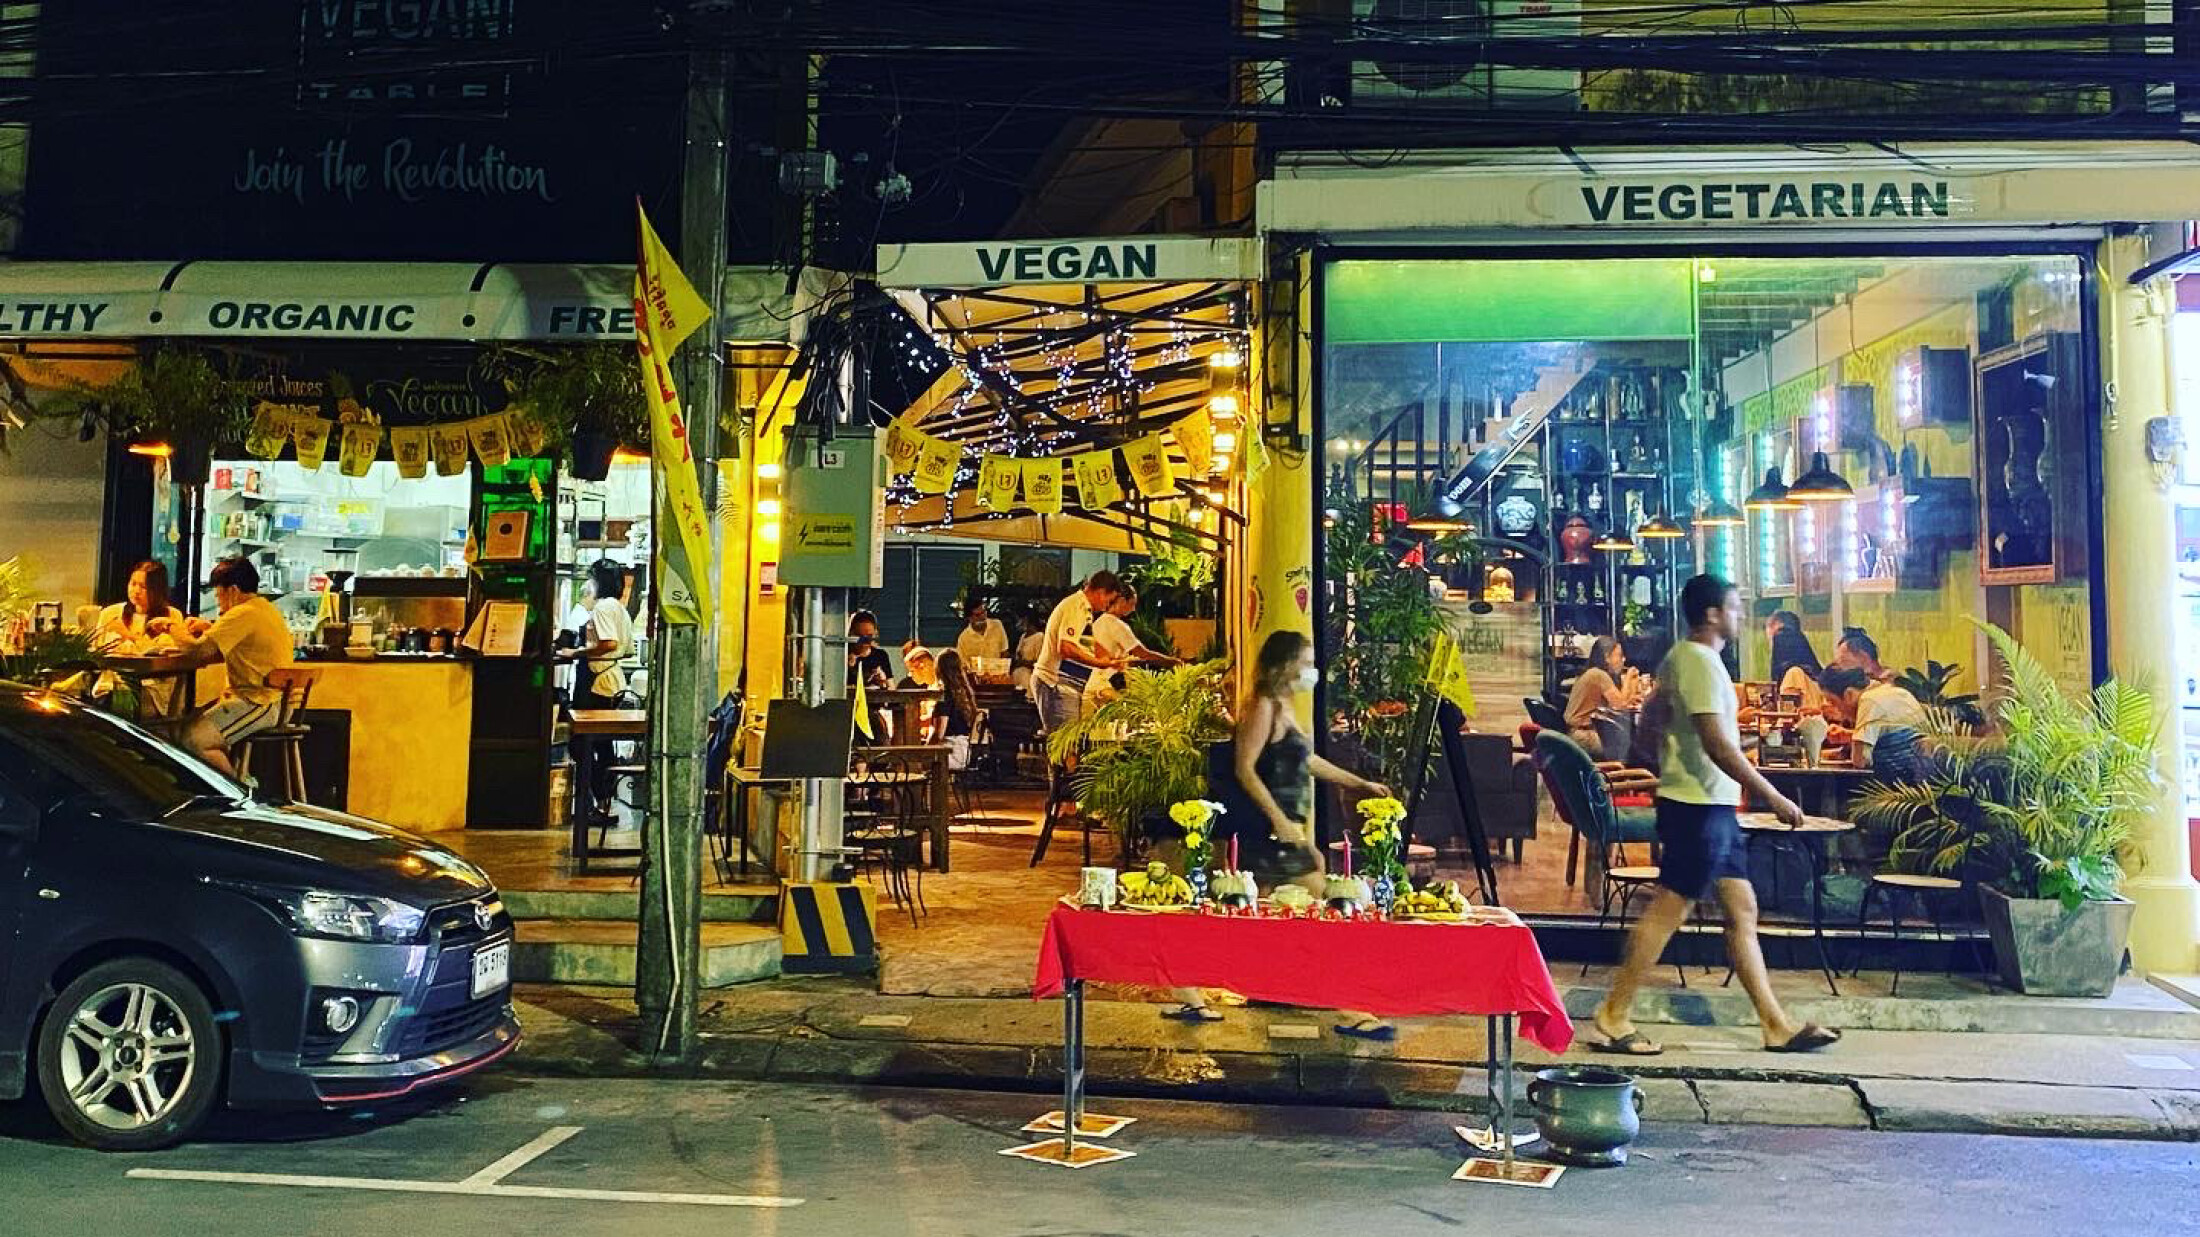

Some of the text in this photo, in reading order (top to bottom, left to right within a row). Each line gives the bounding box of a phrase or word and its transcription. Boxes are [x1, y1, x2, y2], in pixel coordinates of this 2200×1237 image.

[232, 137, 560, 206] Join the Revolution
[1582, 182, 1949, 221] VEGETARIAN
[977, 244, 1157, 280] VEGAN
[209, 302, 415, 331] ORGANIC
